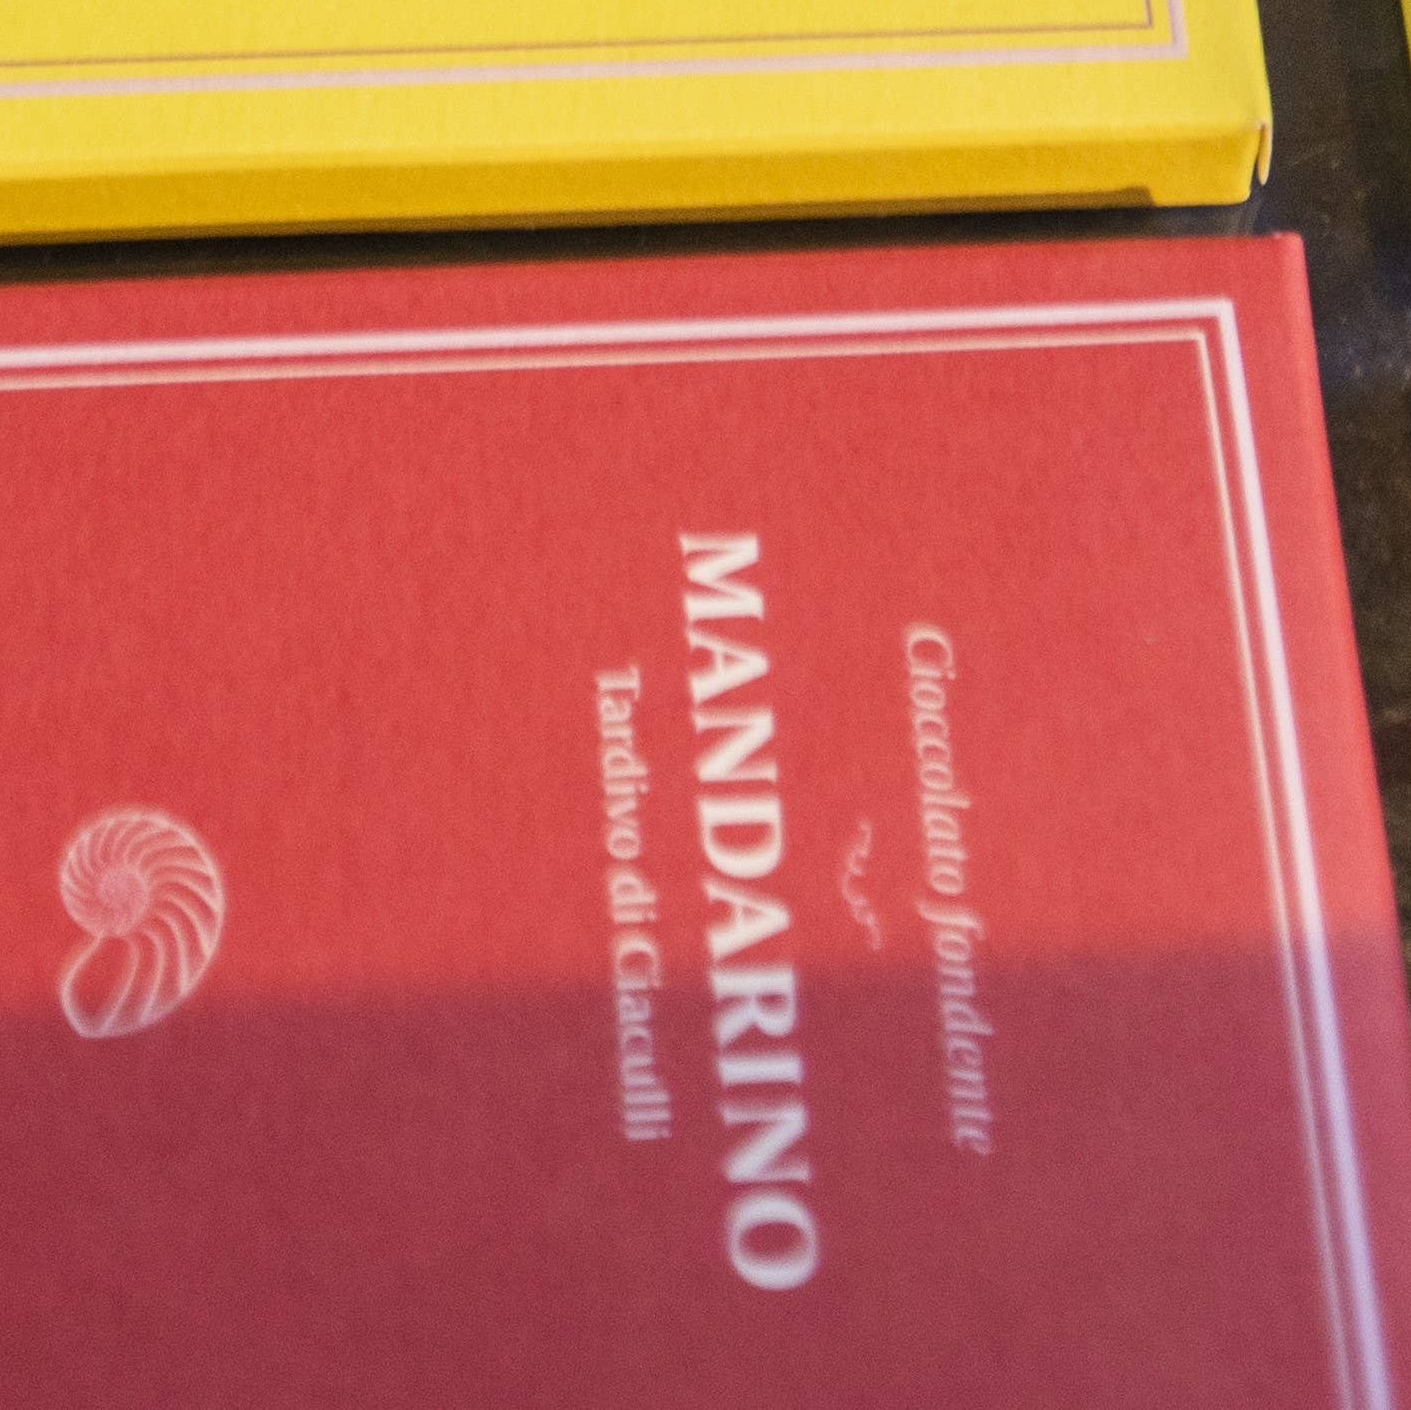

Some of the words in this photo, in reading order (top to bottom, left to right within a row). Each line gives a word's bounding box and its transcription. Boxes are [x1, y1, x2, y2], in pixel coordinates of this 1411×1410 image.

[595, 665, 651, 862] Tardivo
[903, 623, 972, 897] Cioccolato
[608, 866, 657, 925] di
[677, 530, 820, 1293] MANDARINO
[612, 929, 673, 1142] Ciaculli
[918, 897, 994, 1157] fondente
